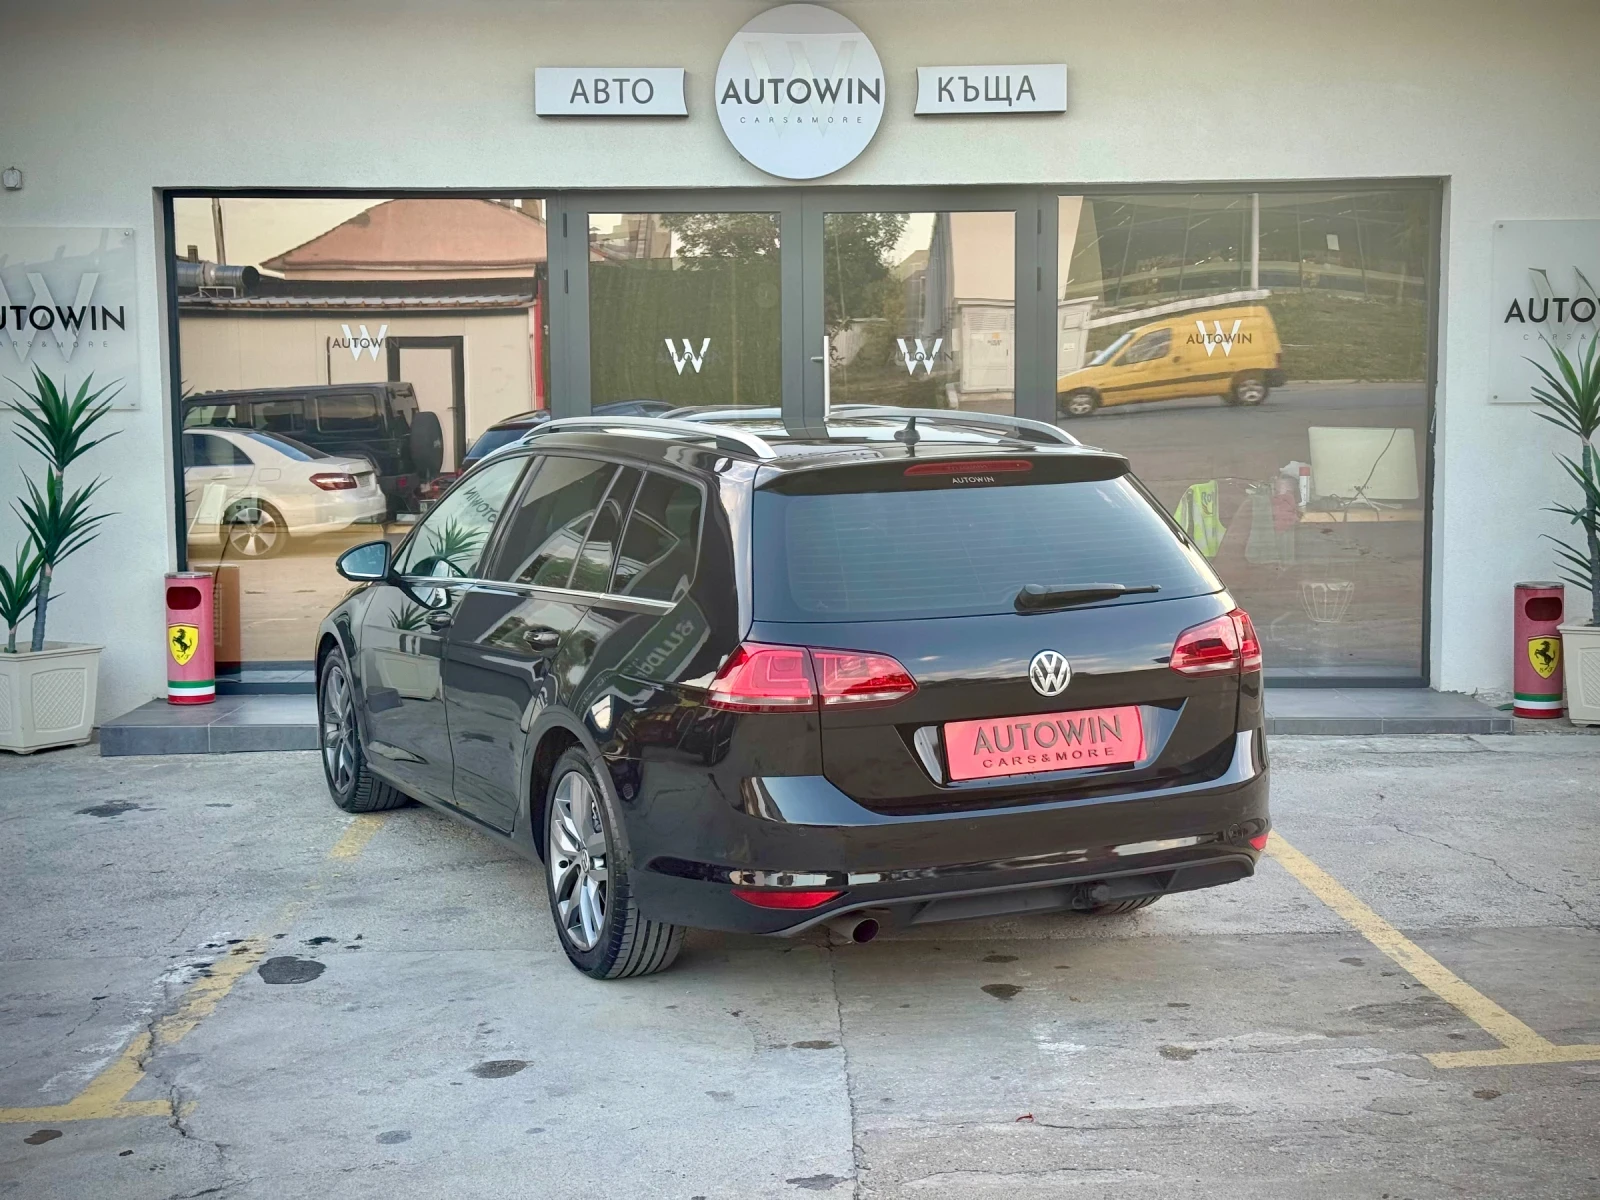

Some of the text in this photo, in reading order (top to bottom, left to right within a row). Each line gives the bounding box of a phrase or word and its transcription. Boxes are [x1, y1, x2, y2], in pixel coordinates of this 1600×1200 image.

[569, 78, 654, 104] АВТО
[720, 77, 881, 105] AUTOWIN
[937, 75, 1036, 107] КЪЩА
[739, 116, 862, 124] CARS&MORE
[1503, 297, 1600, 323] AUTO
[1185, 333, 1253, 345] AUTOWIN
[952, 476, 995, 484] AUTOWIN
[973, 714, 1123, 756] AUTOWIN
[982, 746, 1115, 769] CARS&MORE
